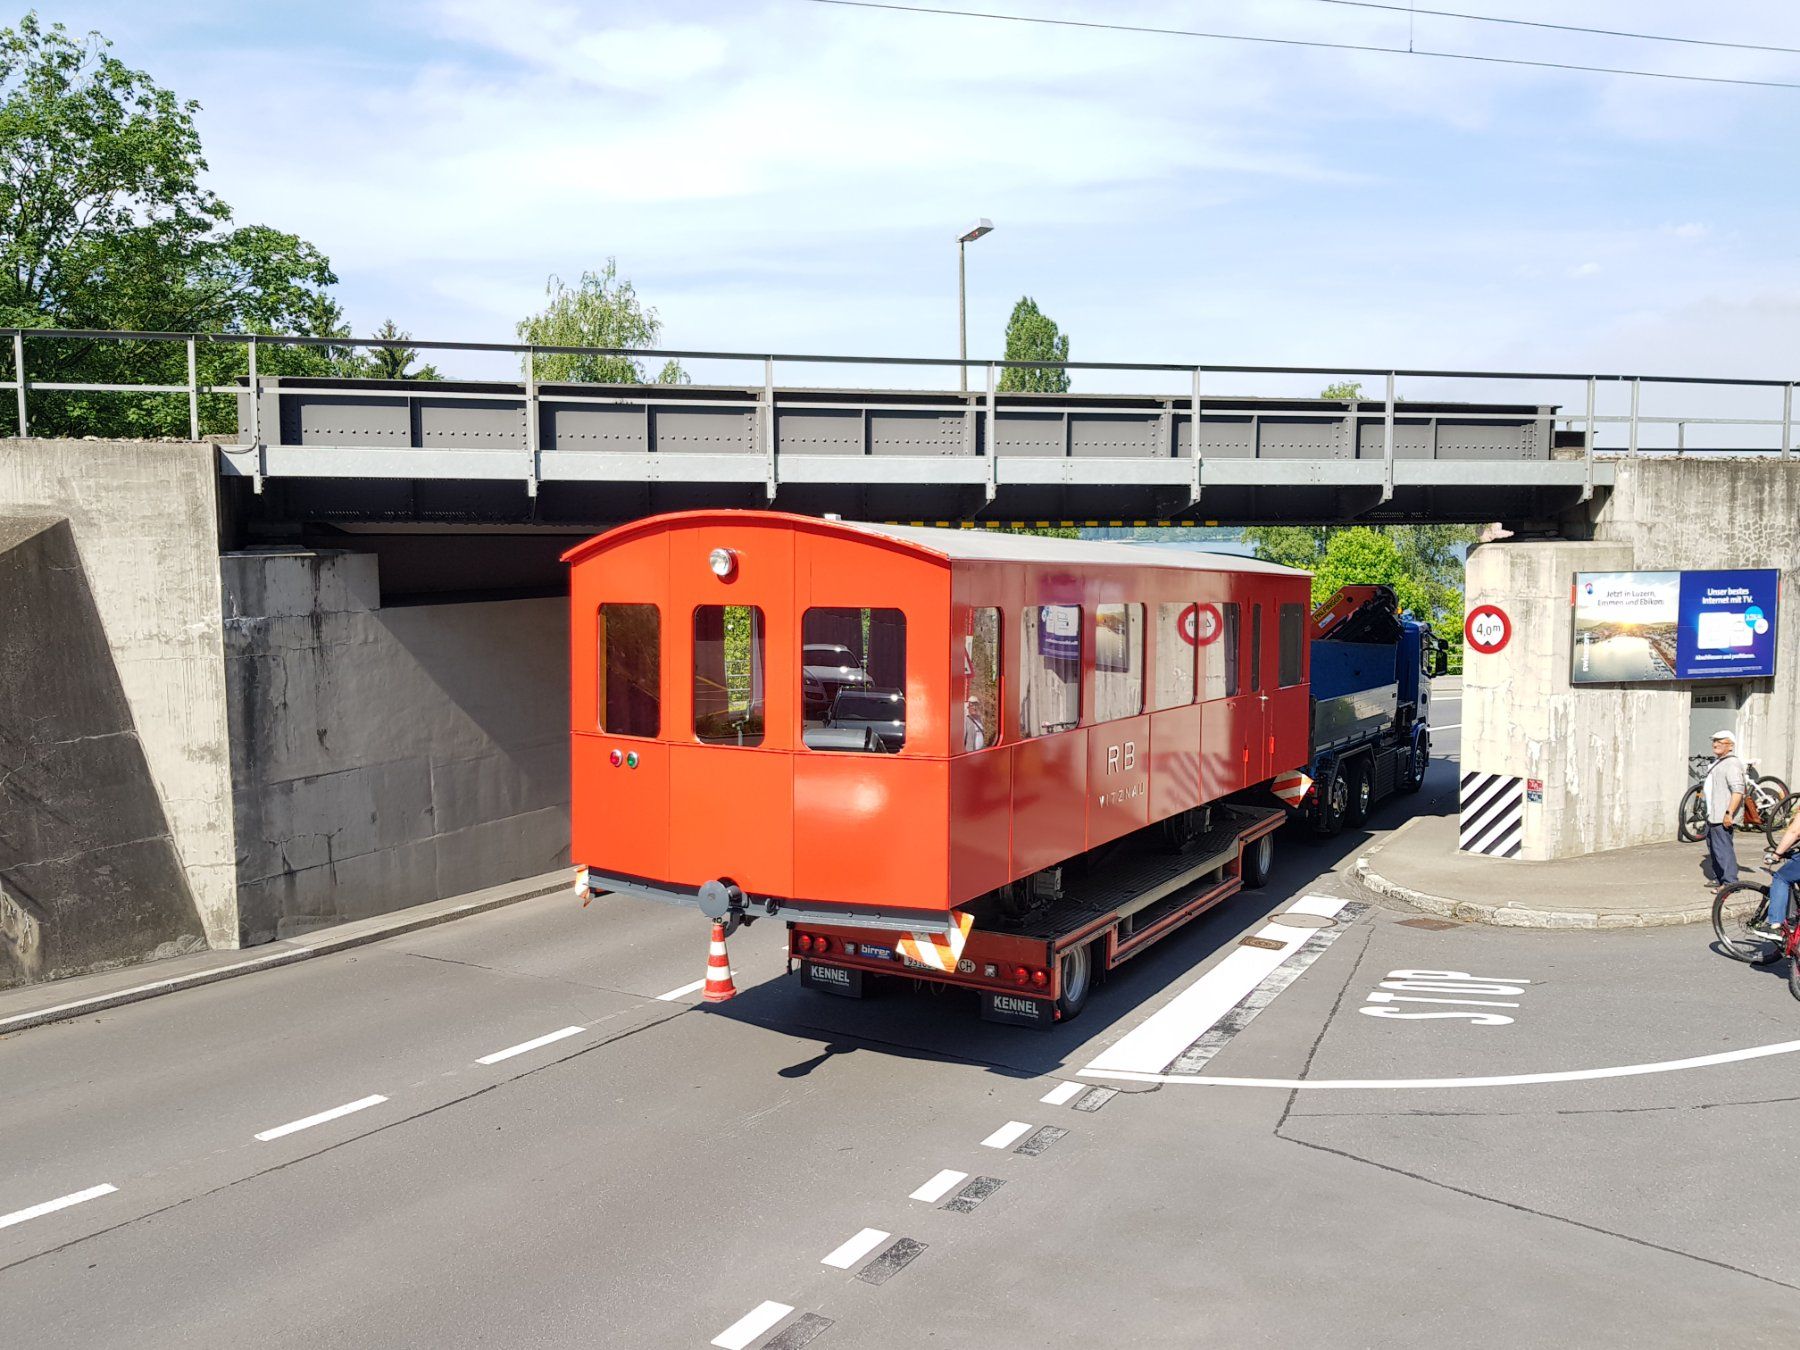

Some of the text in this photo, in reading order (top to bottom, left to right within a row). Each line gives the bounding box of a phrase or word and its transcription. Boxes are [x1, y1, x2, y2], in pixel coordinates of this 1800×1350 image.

[1606, 590, 1657, 598] Jetzt in Luzern,
[1707, 587, 1750, 596] Unser bestes
[1314, 592, 1344, 621] PALFINGER
[1702, 596, 1730, 605] Internet
[1730, 596, 1742, 604] mit
[1106, 741, 1135, 775] RB
[1099, 781, 1144, 808] VITZNAU
[861, 944, 890, 956] birrer
[811, 965, 850, 982] KENNEL
[960, 960, 972, 972] CH
[994, 995, 1039, 1015] KENNEL
[1358, 969, 1531, 1026] STOP
